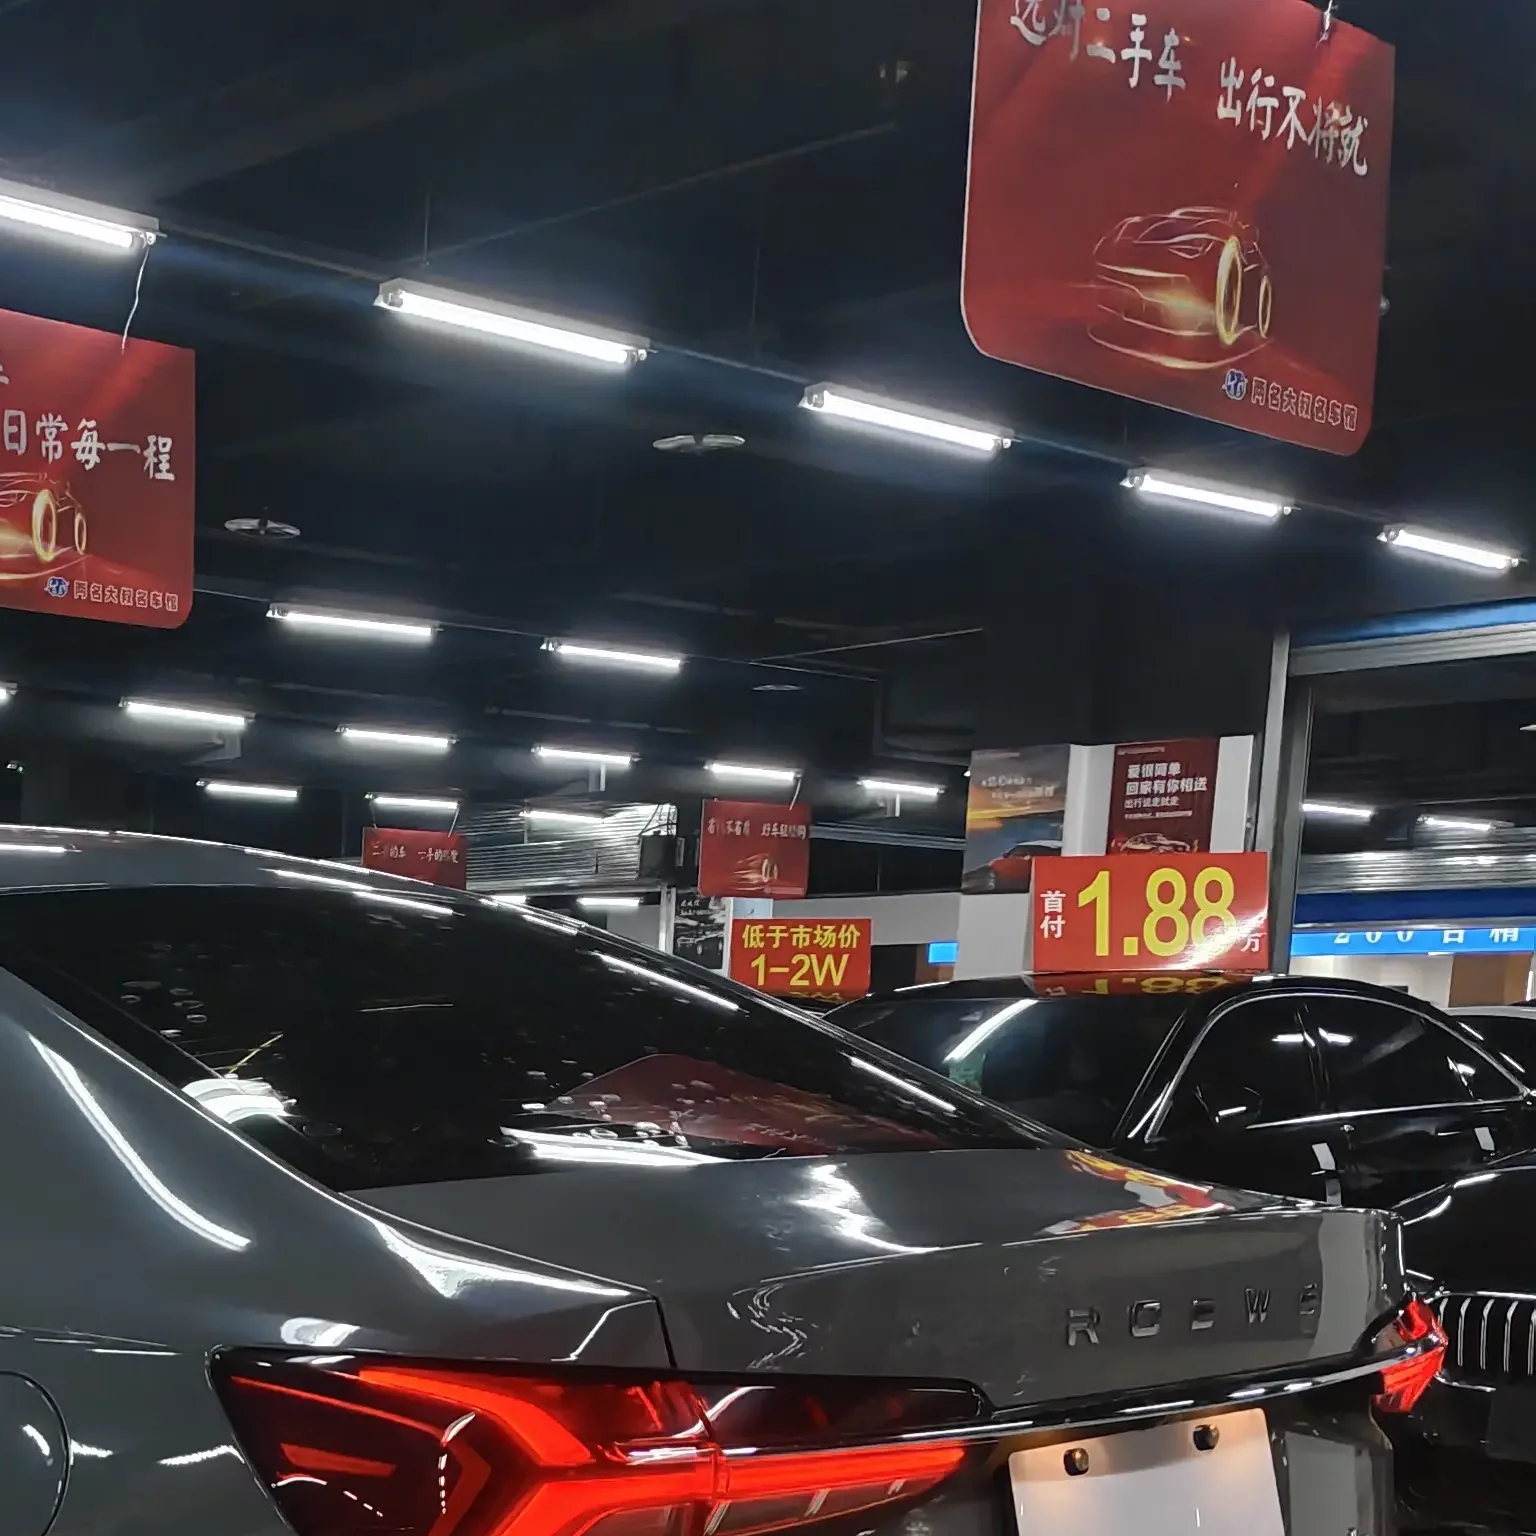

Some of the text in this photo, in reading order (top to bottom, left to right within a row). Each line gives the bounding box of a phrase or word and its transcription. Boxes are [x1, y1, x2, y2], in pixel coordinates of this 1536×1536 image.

[1216, 57, 1368, 176] 出行不将就
[742, 924, 861, 949] 低于市场价
[1040, 866, 1267, 957] 首付 1.88 万
[750, 953, 850, 986] 1-2W
